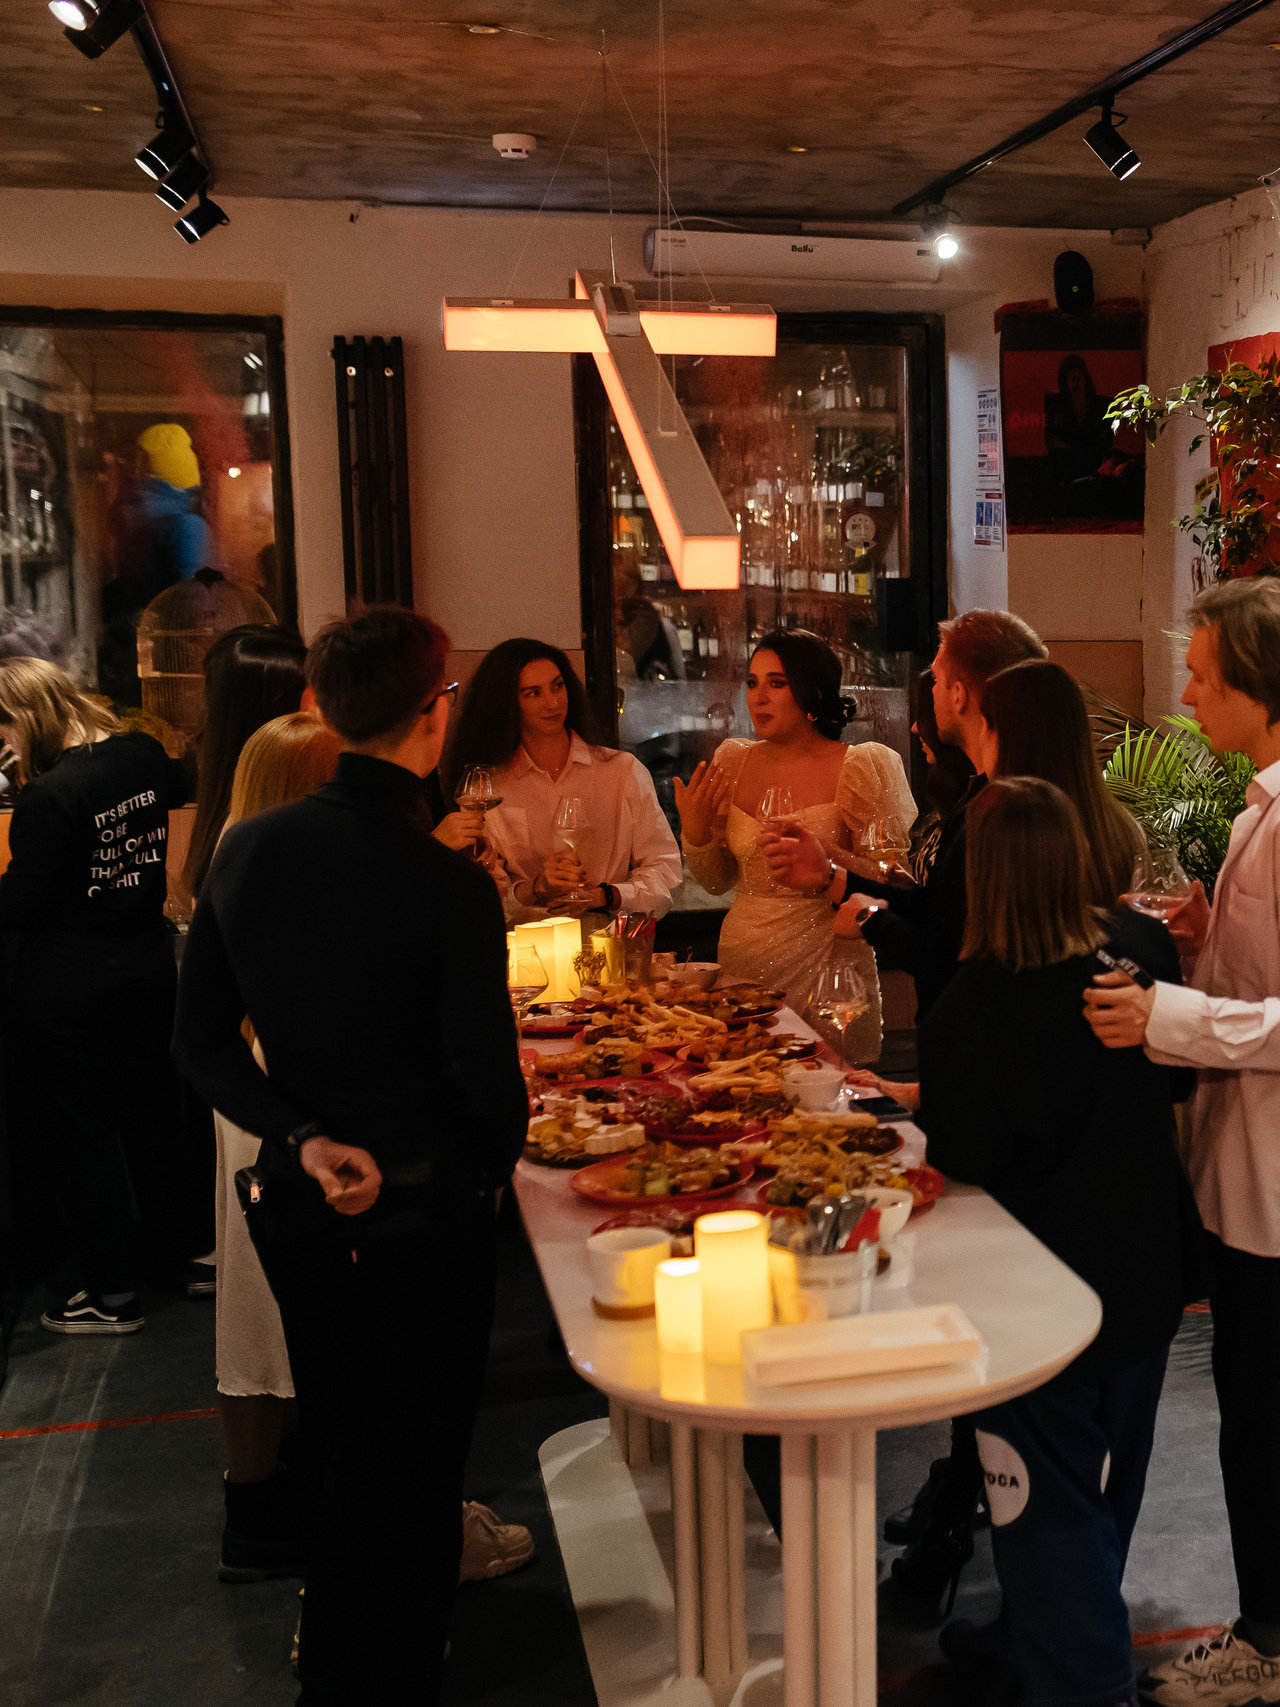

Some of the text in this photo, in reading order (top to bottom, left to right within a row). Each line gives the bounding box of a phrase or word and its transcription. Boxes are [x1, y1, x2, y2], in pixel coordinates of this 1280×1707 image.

[791, 244, 814, 253] Ballu
[95, 790, 157, 829] IT'S BETTER
[116, 822, 128, 838] BE
[92, 845, 122, 861] FULL
[125, 836, 144, 852] OF
